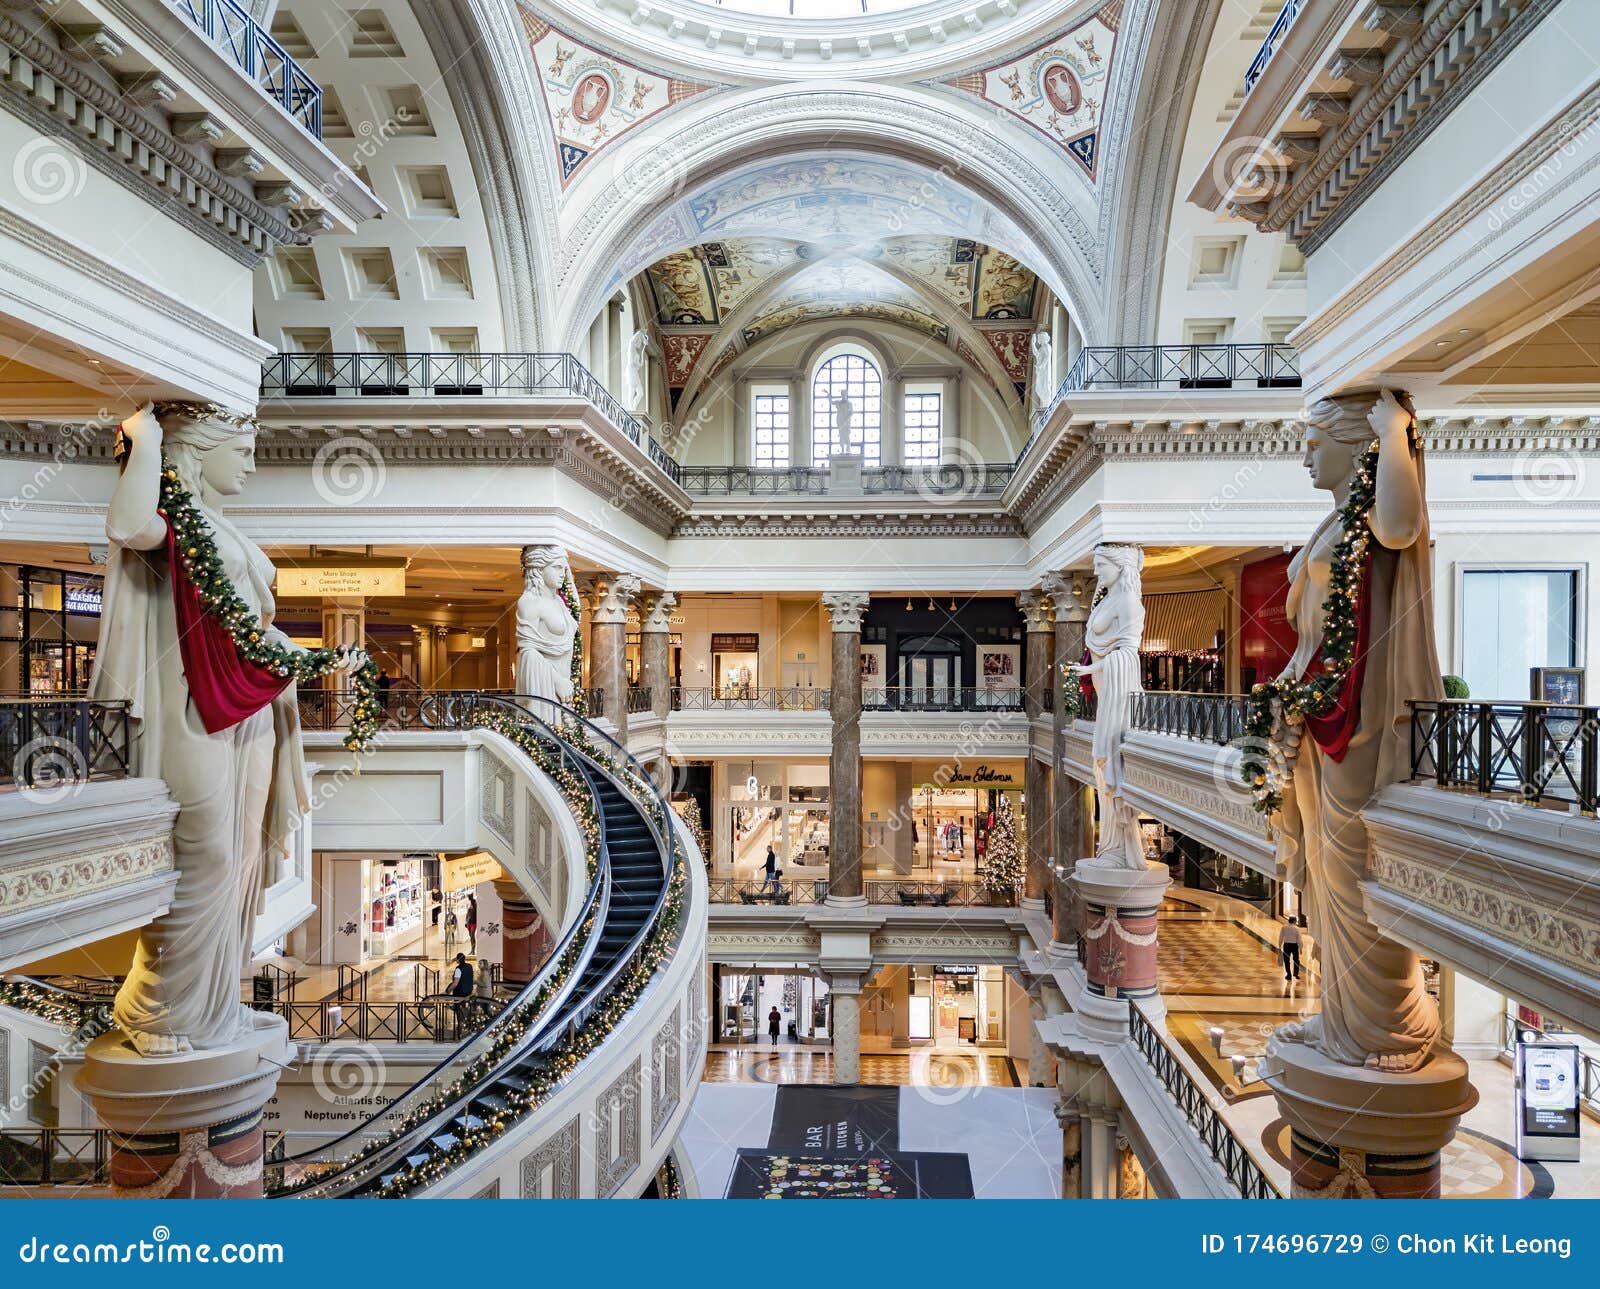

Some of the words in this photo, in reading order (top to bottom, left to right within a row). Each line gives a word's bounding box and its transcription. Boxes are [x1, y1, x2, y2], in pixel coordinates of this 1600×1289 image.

[950, 763, 971, 783] Sam
[973, 764, 1014, 783] Edelman
[967, 964, 978, 973] hut
[333, 1095, 373, 1105] Atlantis
[375, 1095, 395, 1105] Sho
[304, 1110, 356, 1121] Neptune's
[804, 1125, 824, 1148] BAR
[836, 1120, 848, 1149] KITCHEN
